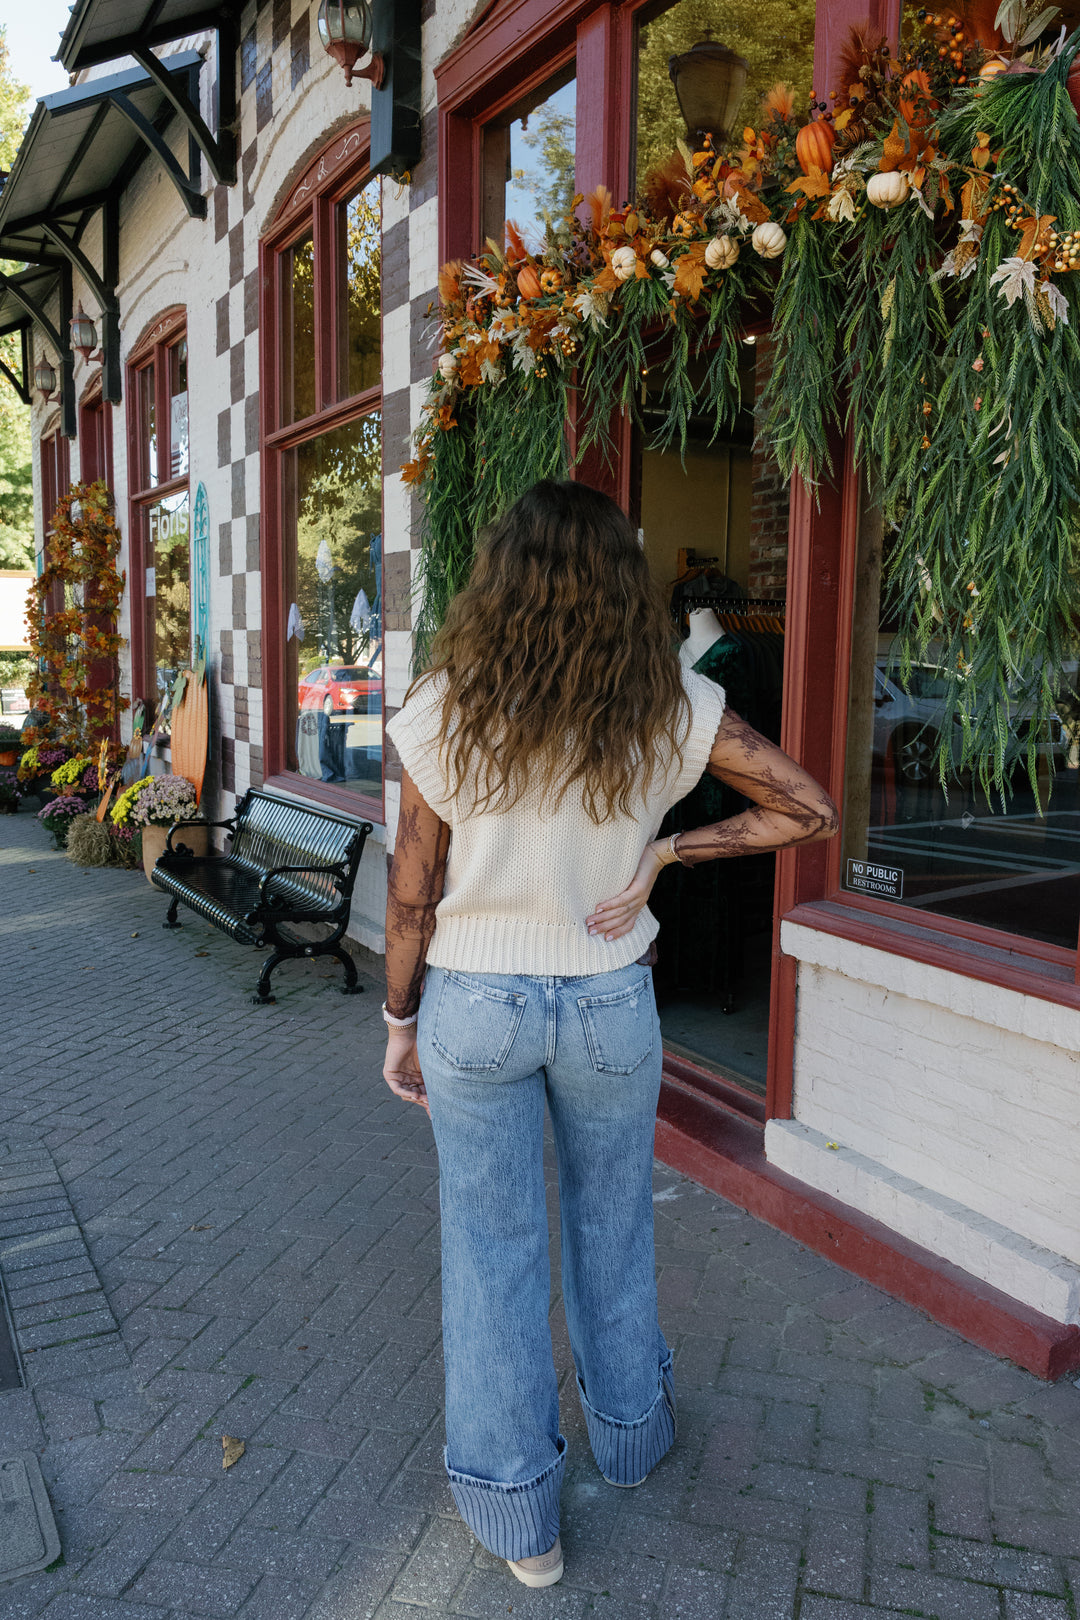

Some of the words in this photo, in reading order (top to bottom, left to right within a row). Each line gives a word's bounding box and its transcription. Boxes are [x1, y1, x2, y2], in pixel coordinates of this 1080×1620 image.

[852, 863, 864, 874] NO
[866, 866, 898, 882] PUBLIC
[852, 878, 897, 895] RESTROOMS
